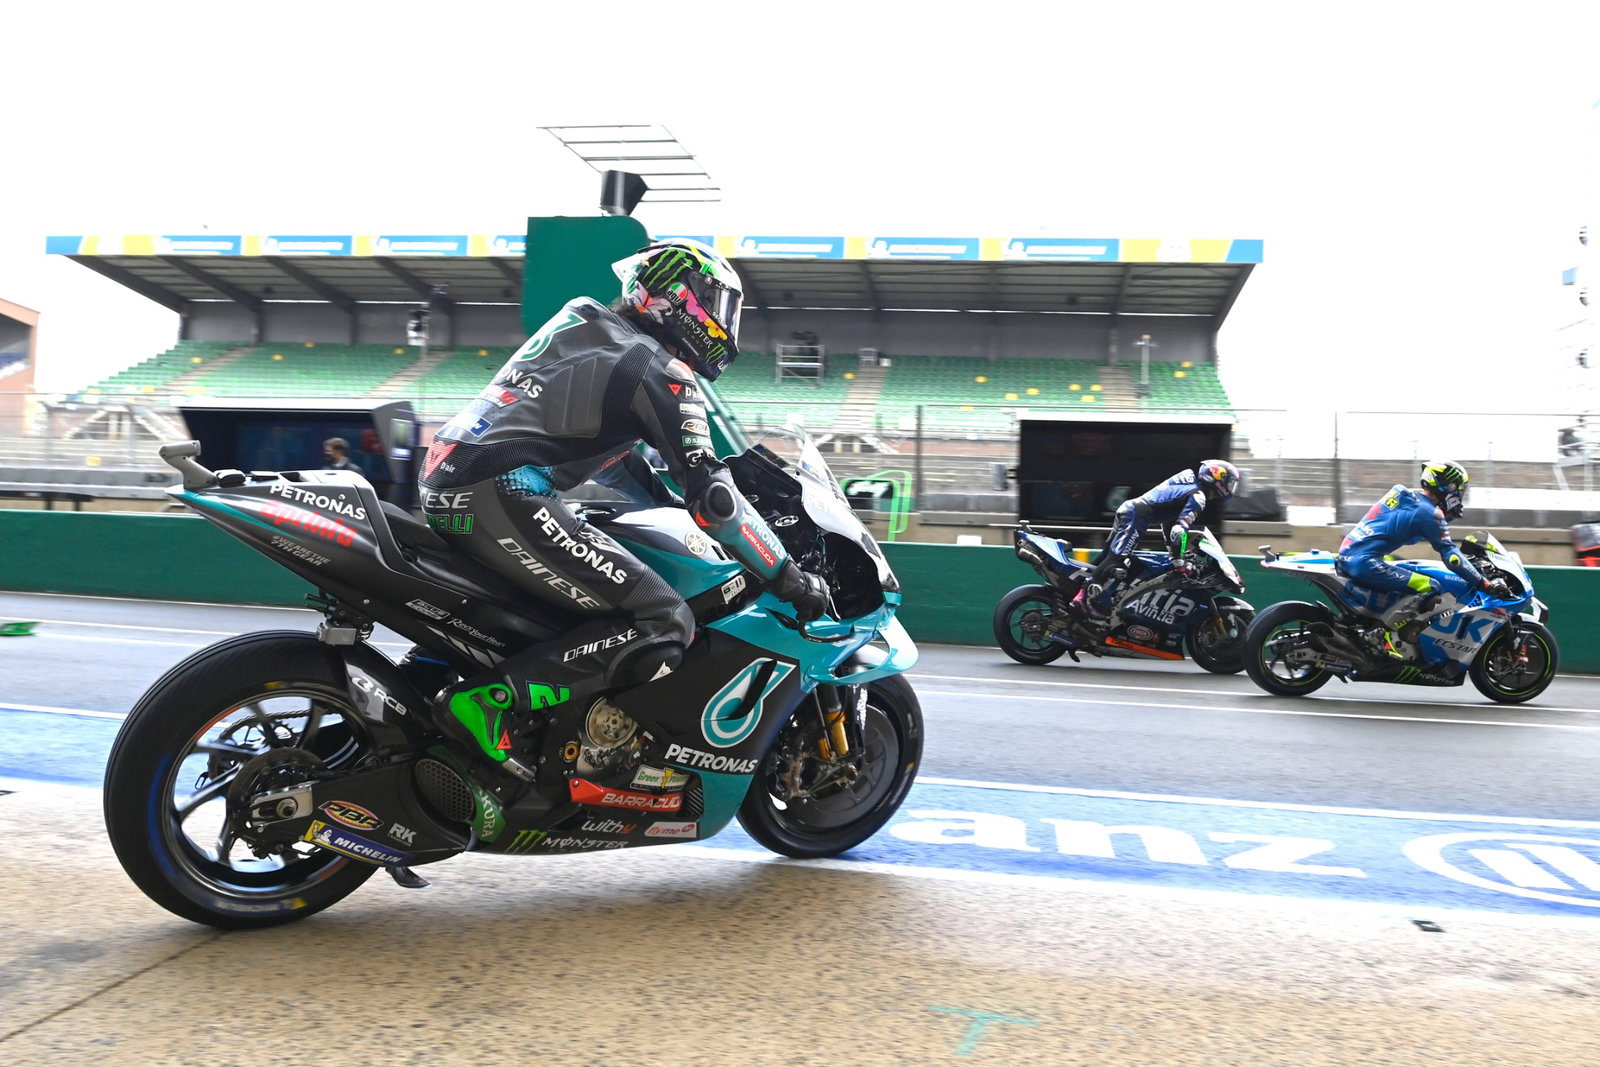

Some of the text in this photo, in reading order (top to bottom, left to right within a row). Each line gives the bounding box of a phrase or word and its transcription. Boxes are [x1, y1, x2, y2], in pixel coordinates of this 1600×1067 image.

[269, 484, 366, 520] PETRONAS
[533, 507, 628, 584] PETRONAS
[741, 526, 775, 566] BARRACUDA
[497, 538, 600, 609] DAINESE
[1125, 600, 1176, 625] Avintia
[563, 628, 638, 663] DAINESE
[1434, 638, 1478, 655] ECSTAR
[373, 689, 408, 716] RCB
[664, 743, 759, 774] PETRONAS
[637, 771, 660, 783] Green
[388, 822, 417, 844] RK
[541, 836, 630, 850] MONSTER
[333, 837, 402, 863] MICHELIN
